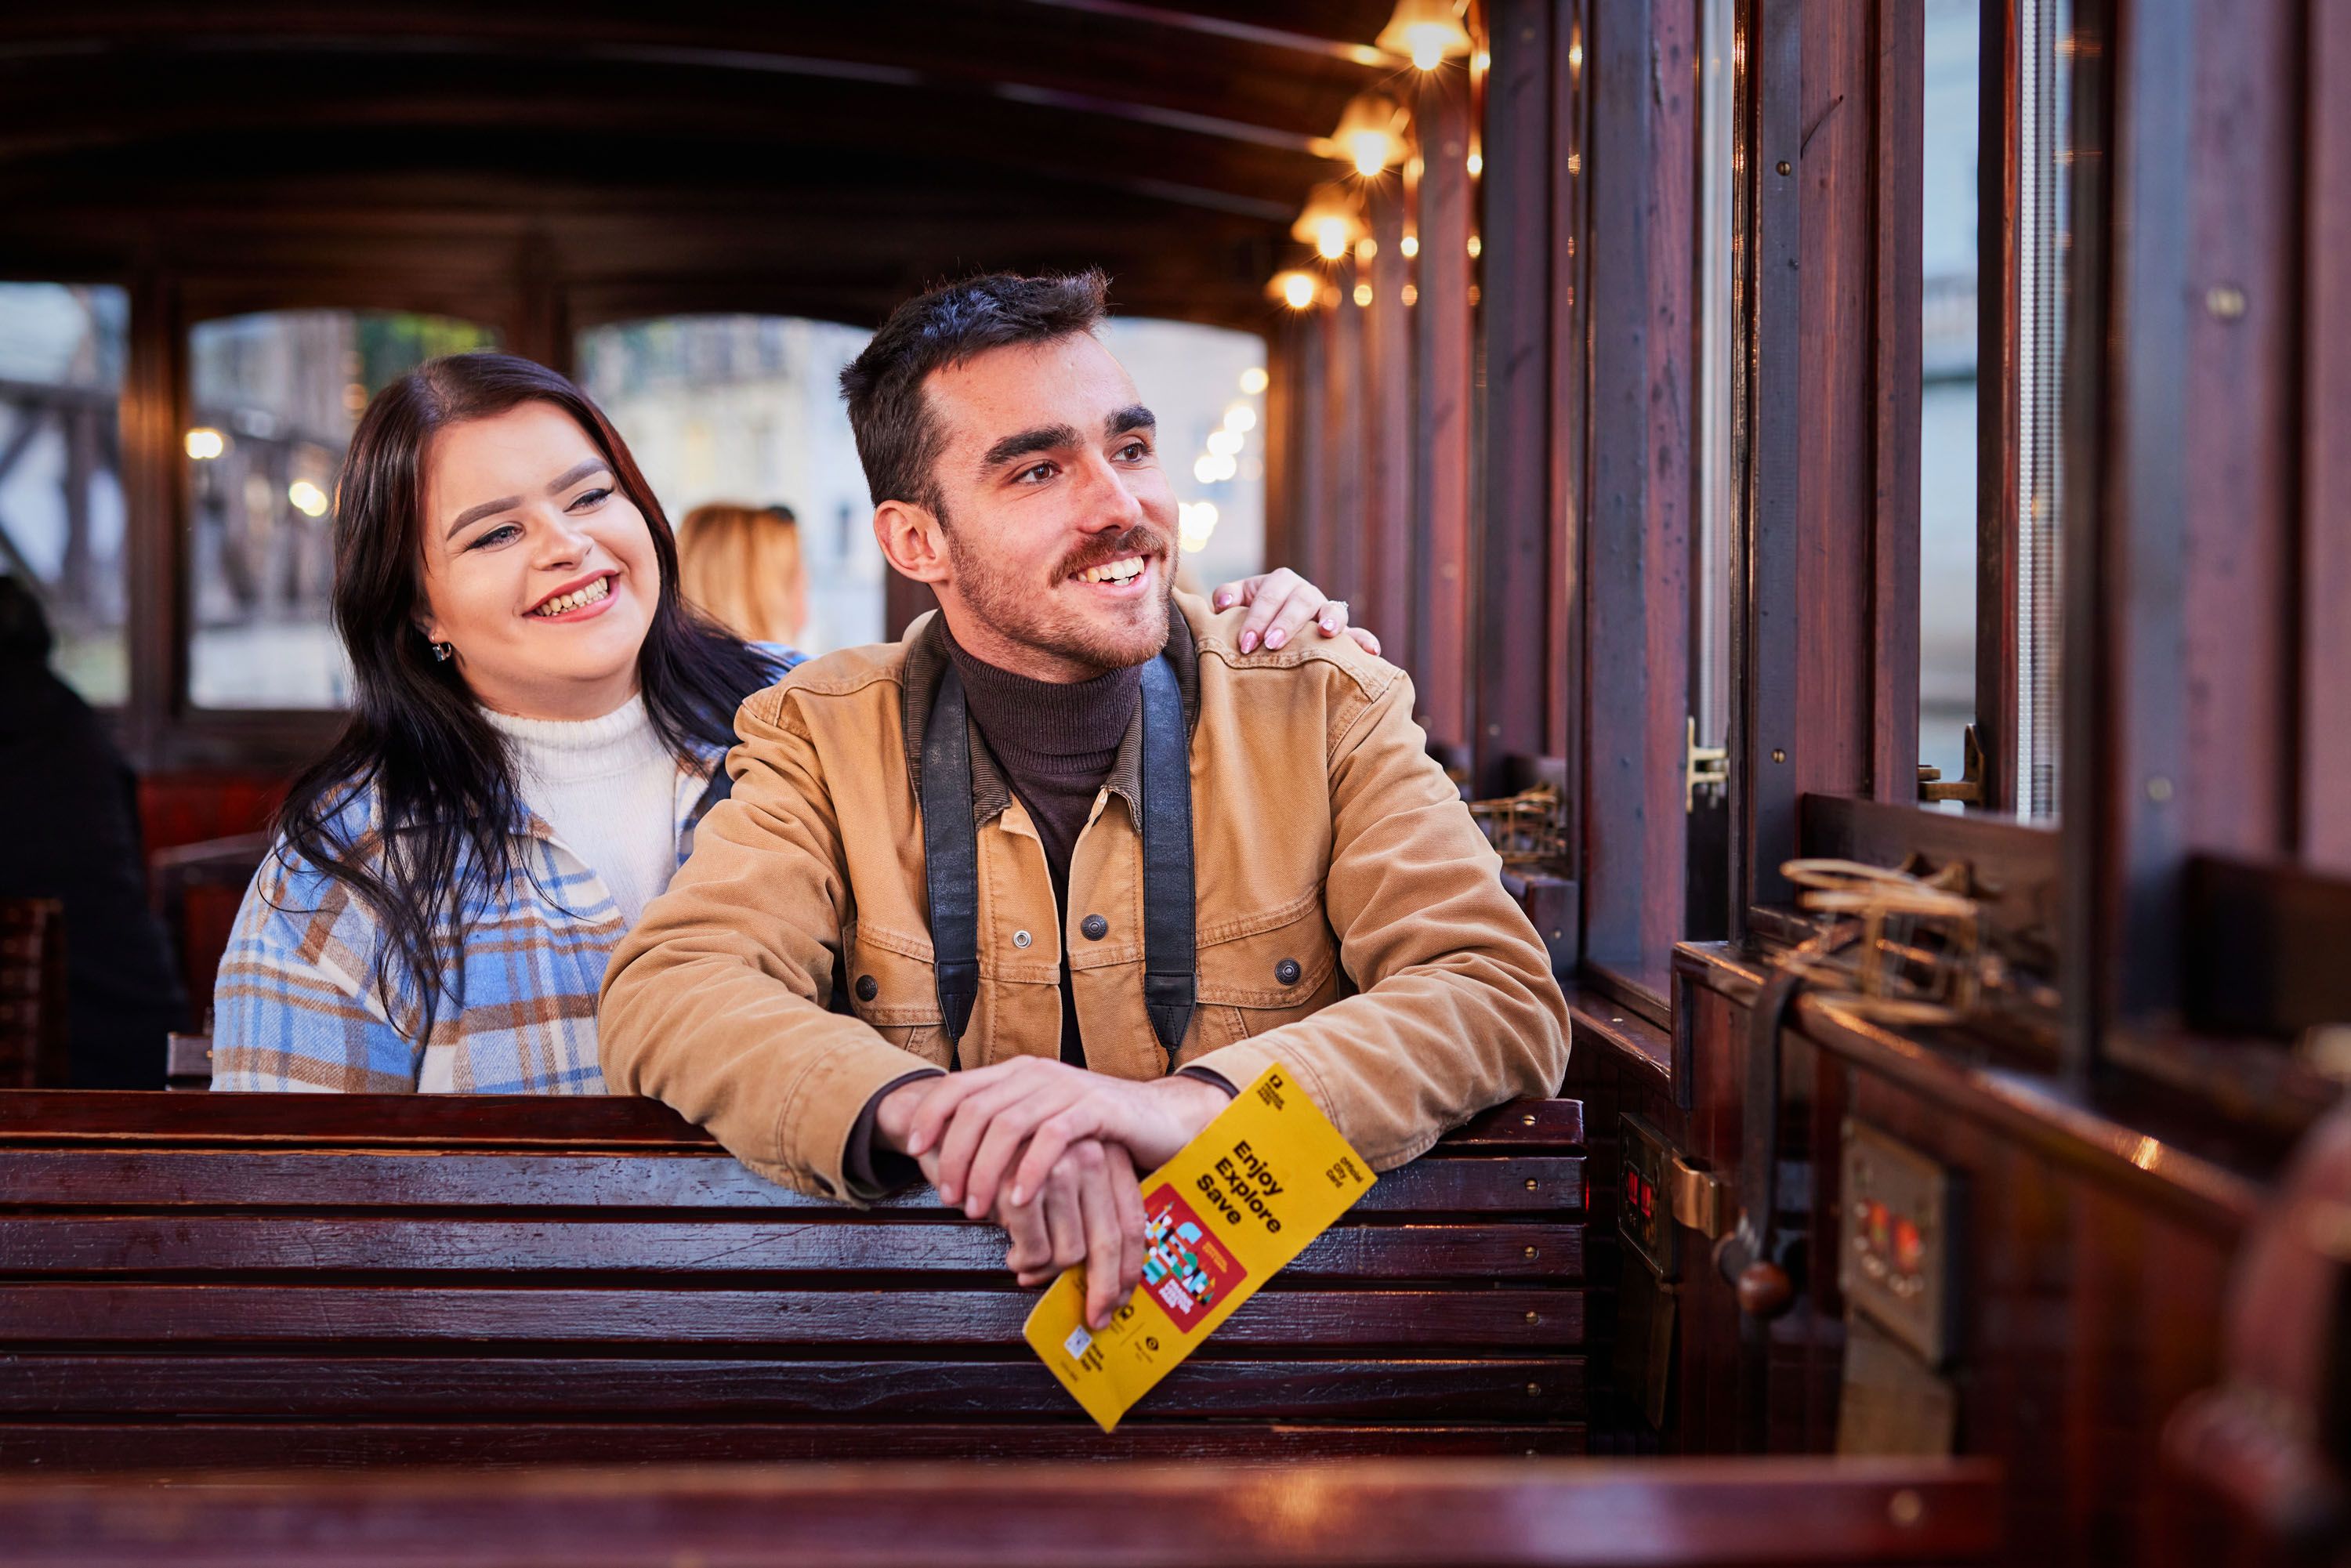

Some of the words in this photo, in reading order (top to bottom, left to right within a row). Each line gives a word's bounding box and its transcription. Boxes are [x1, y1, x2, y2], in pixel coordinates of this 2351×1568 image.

[1233, 1140, 1284, 1197] Enjoy
[1325, 1168, 1343, 1189] Card
[1333, 1162, 1346, 1180] City
[1339, 1156, 1364, 1183] Official
[1196, 1173, 1241, 1225] Save
[1214, 1157, 1281, 1233] Explore
